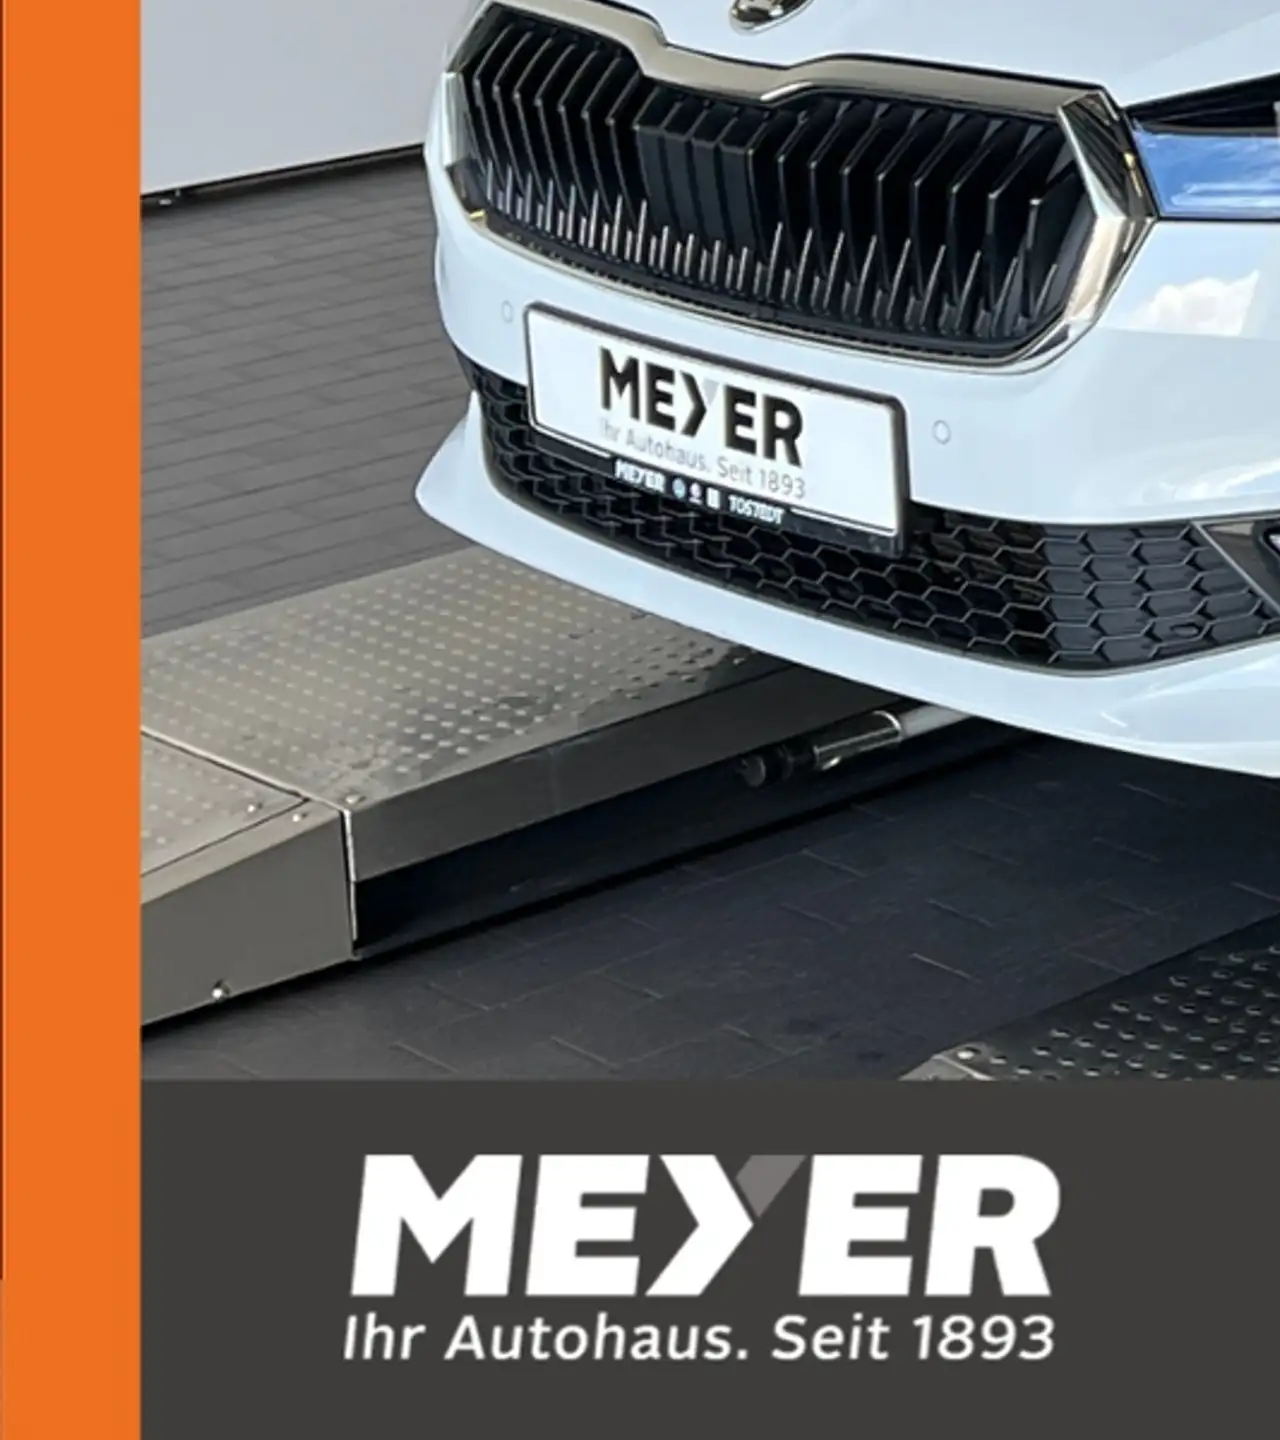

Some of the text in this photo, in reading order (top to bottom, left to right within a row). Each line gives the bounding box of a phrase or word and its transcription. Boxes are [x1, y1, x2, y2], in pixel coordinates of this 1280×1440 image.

[600, 346, 804, 469] MEYER
[600, 418, 807, 500] Ihr Autohaus. Seit 1893
